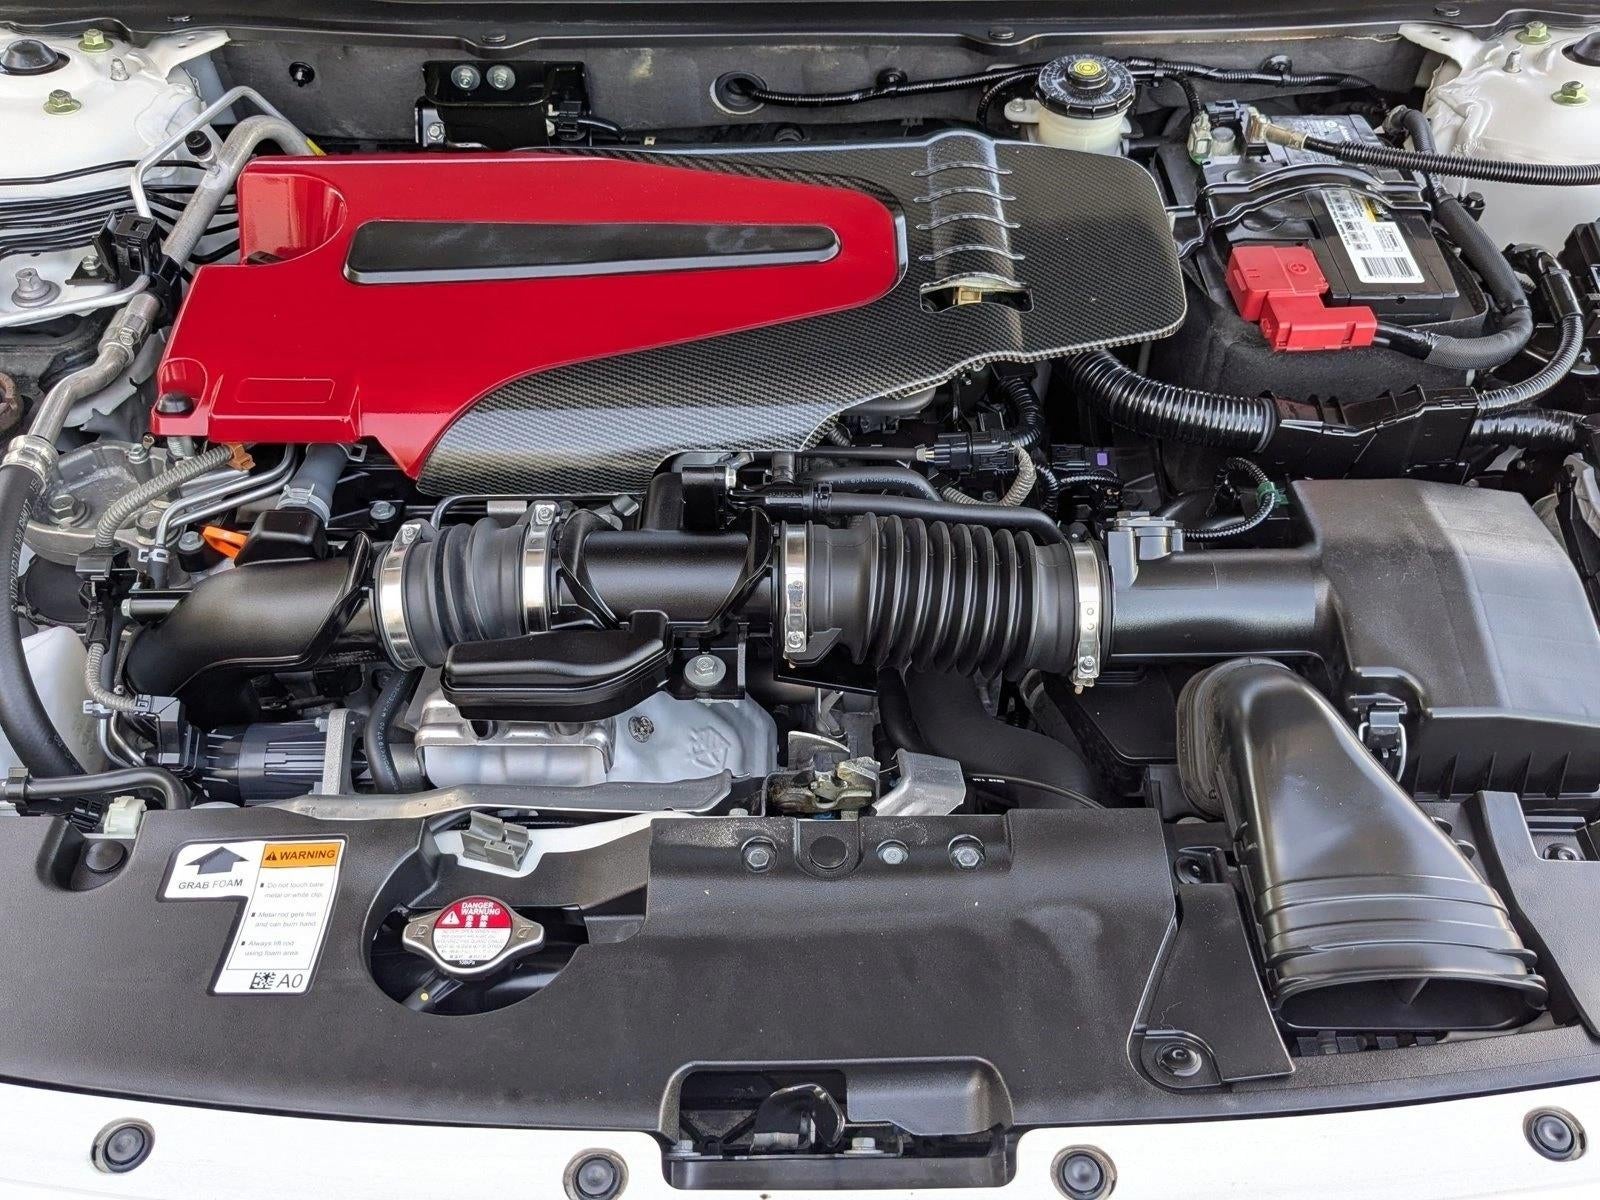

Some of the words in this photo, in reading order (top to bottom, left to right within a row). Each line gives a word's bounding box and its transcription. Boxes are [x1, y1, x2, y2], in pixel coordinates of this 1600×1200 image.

[279, 849, 336, 861] WARNING
[178, 881, 209, 890] GRAB
[212, 878, 244, 888] FOAM
[461, 908, 501, 916] WARNUNG
[276, 973, 304, 989] A0
